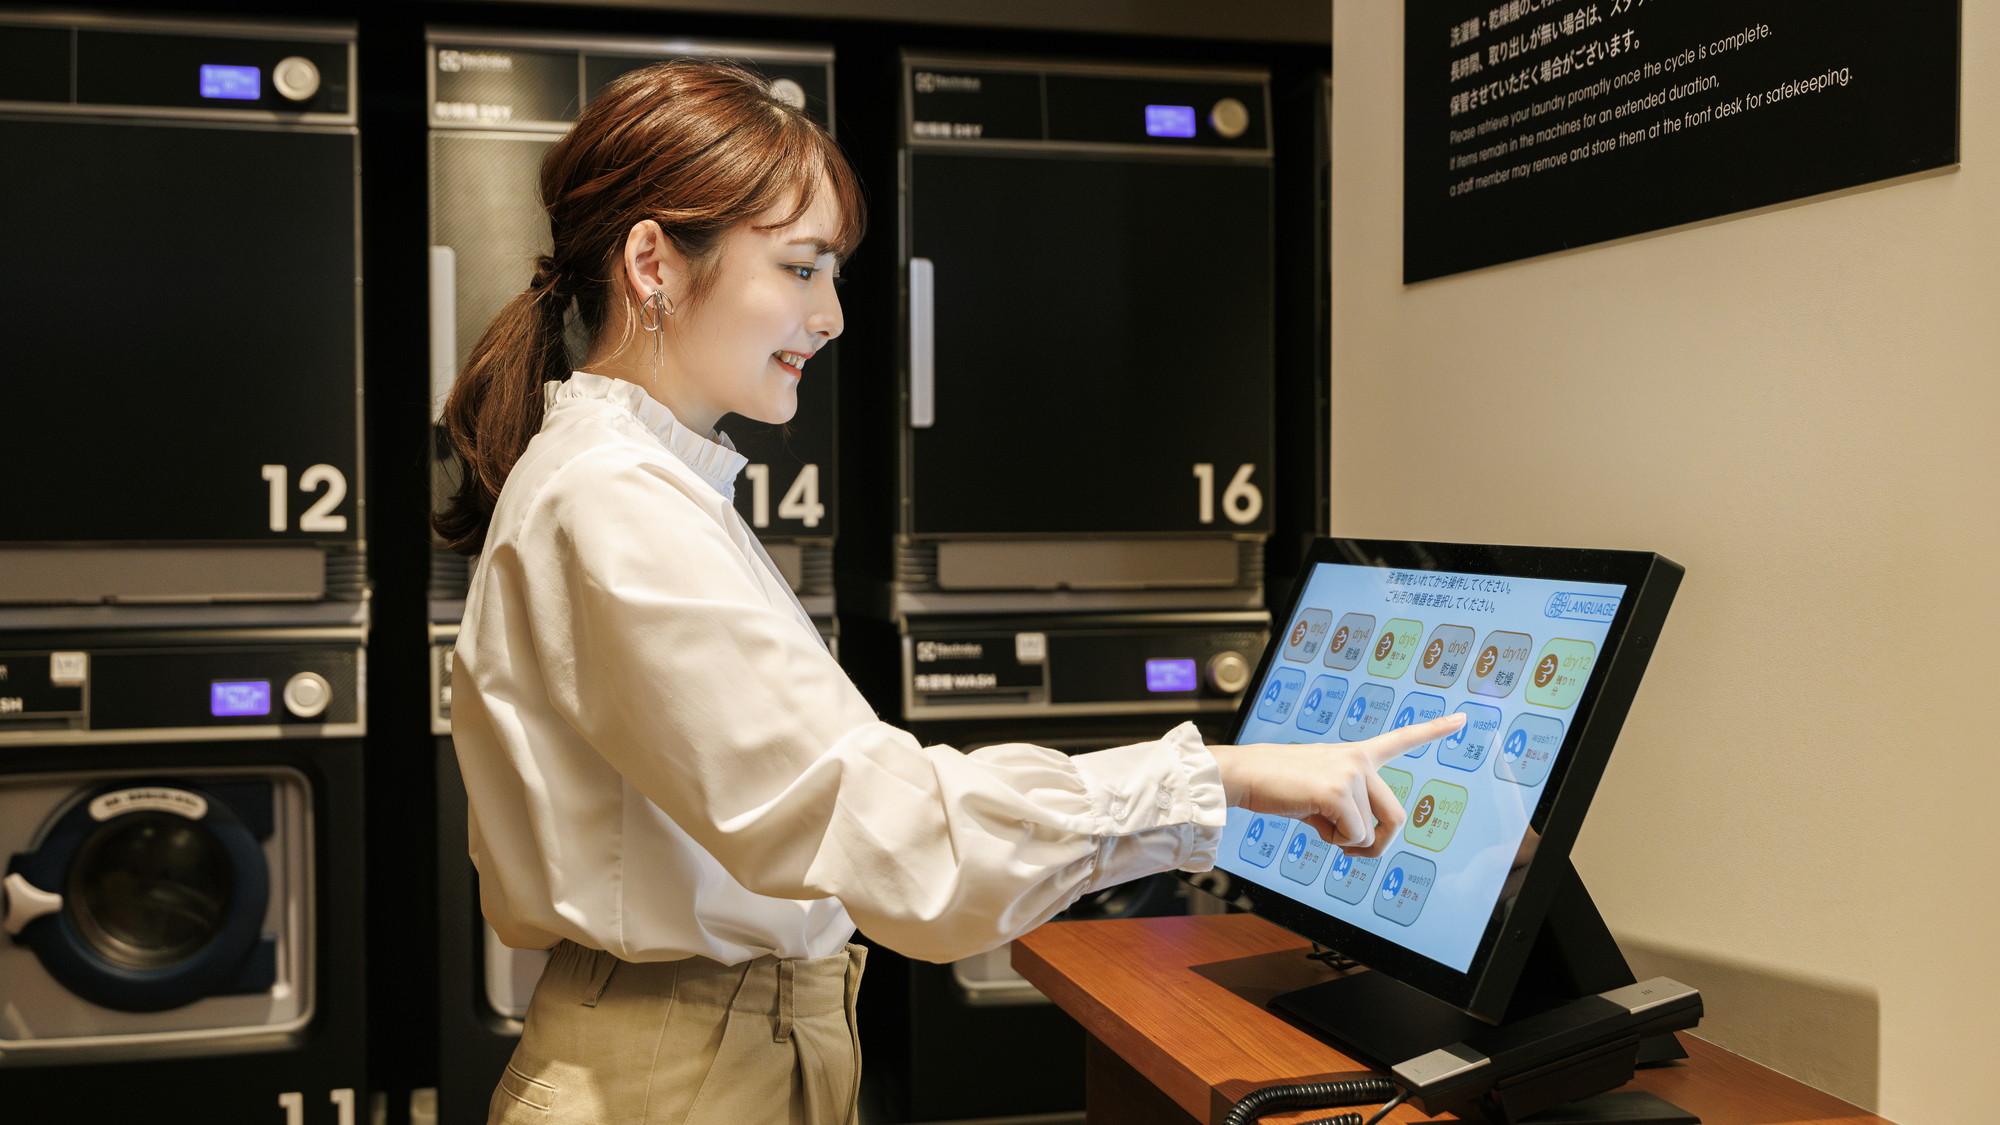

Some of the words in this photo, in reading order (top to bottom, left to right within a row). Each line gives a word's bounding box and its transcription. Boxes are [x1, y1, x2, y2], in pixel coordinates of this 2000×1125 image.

[1450, 28, 1640, 117] 保管させていただく場合がございます。
[1450, 127, 1476, 144] Please
[1477, 117, 1509, 135] retrieve
[1511, 107, 1530, 127] your
[1531, 94, 1566, 117] laundry
[1568, 78, 1611, 108] promptly
[1613, 68, 1641, 89] once
[1643, 62, 1662, 79] the
[1664, 48, 1695, 72] cycle
[1698, 44, 1706, 60] is
[1709, 23, 1773, 56] complete.
[1457, 152, 1478, 168] items
[1479, 140, 1508, 161] remain
[1509, 138, 1518, 152] in
[1520, 133, 1534, 149] the
[1536, 121, 1581, 144] machines
[1583, 113, 1597, 128] for
[1599, 109, 1613, 124] an
[1615, 88, 1666, 119] extended
[1669, 74, 1720, 101] duration,
[1450, 185, 1456, 197] a
[1457, 177, 1474, 195] staff
[1475, 169, 1510, 190] member
[1511, 162, 1531, 178] may
[1533, 152, 1568, 173] remove
[1570, 143, 1590, 162] and
[1592, 137, 1616, 156] store
[1619, 127, 1646, 147] them
[1648, 121, 1660, 139] at
[1663, 118, 1682, 135] the
[1685, 106, 1711, 129] front
[1715, 97, 1743, 120] desk
[1746, 93, 1763, 110] for
[1766, 66, 1853, 105] safekeeping.
[262, 464, 348, 532] 12
[745, 463, 825, 528] 14
[1193, 463, 1263, 525] 16
[1566, 600, 1617, 616] LANGUAGE
[1310, 622, 1327, 635] dry2
[1352, 628, 1370, 643] dry4
[1398, 632, 1417, 649] dry6
[1448, 640, 1470, 658] dry8
[1502, 645, 1528, 662] dry10
[1563, 653, 1591, 671] dry12
[1440, 661, 1458, 677] 乾燥
[1494, 670, 1514, 686] 乾燥
[1370, 700, 1391, 711] wash5
[1419, 708, 1442, 720] wash7
[1473, 718, 1498, 732] wash9
[1531, 733, 1558, 746] wash11
[1439, 797, 1463, 815] dry20
[1408, 874, 1431, 887] wash19
